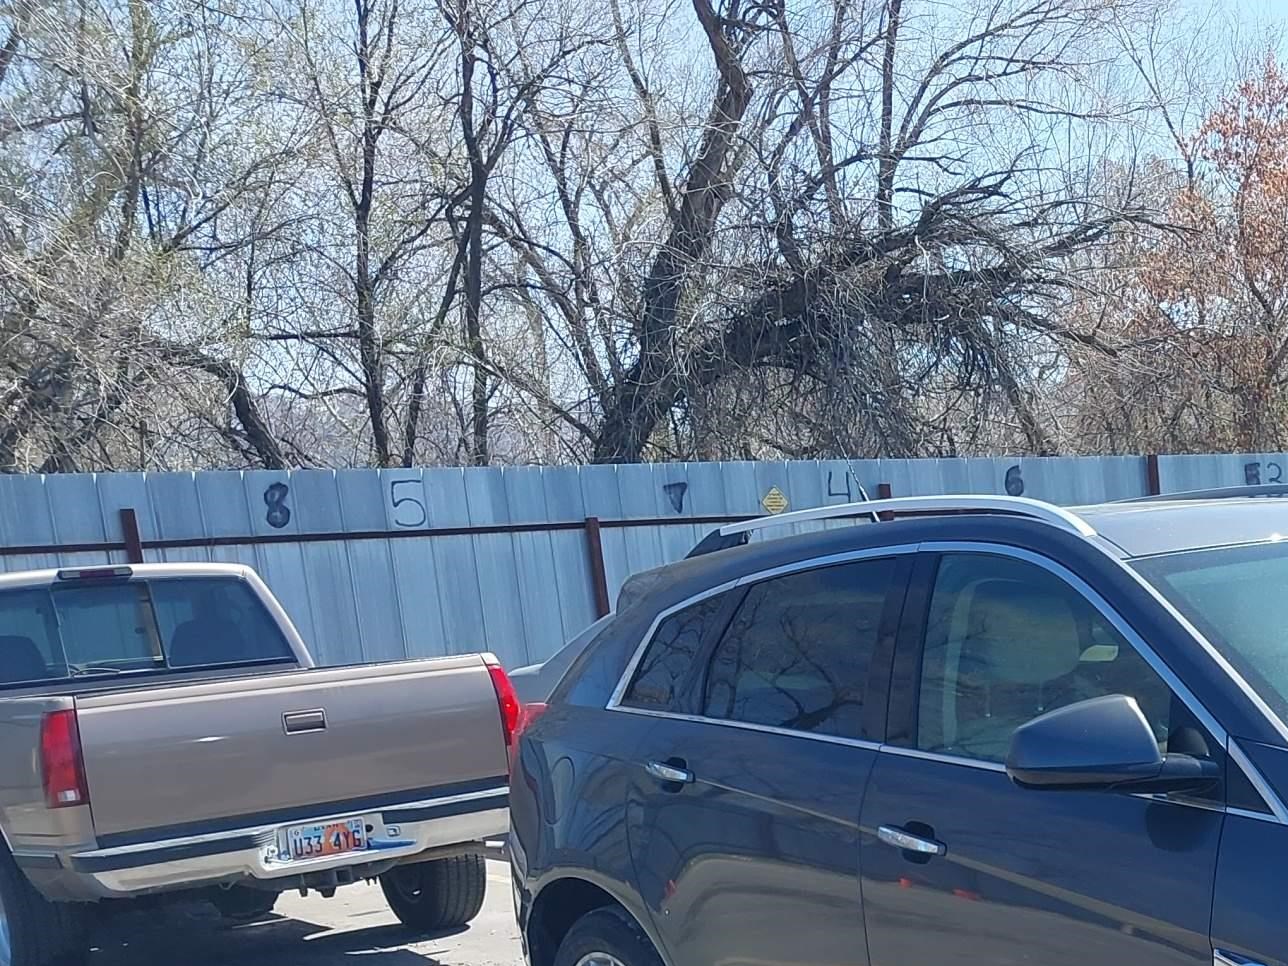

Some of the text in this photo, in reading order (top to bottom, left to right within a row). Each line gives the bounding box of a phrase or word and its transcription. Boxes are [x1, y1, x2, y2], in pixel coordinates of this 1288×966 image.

[828, 471, 851, 503] 4
[1005, 464, 1025, 497] 6
[264, 481, 291, 529] 8
[391, 480, 426, 527] 5
